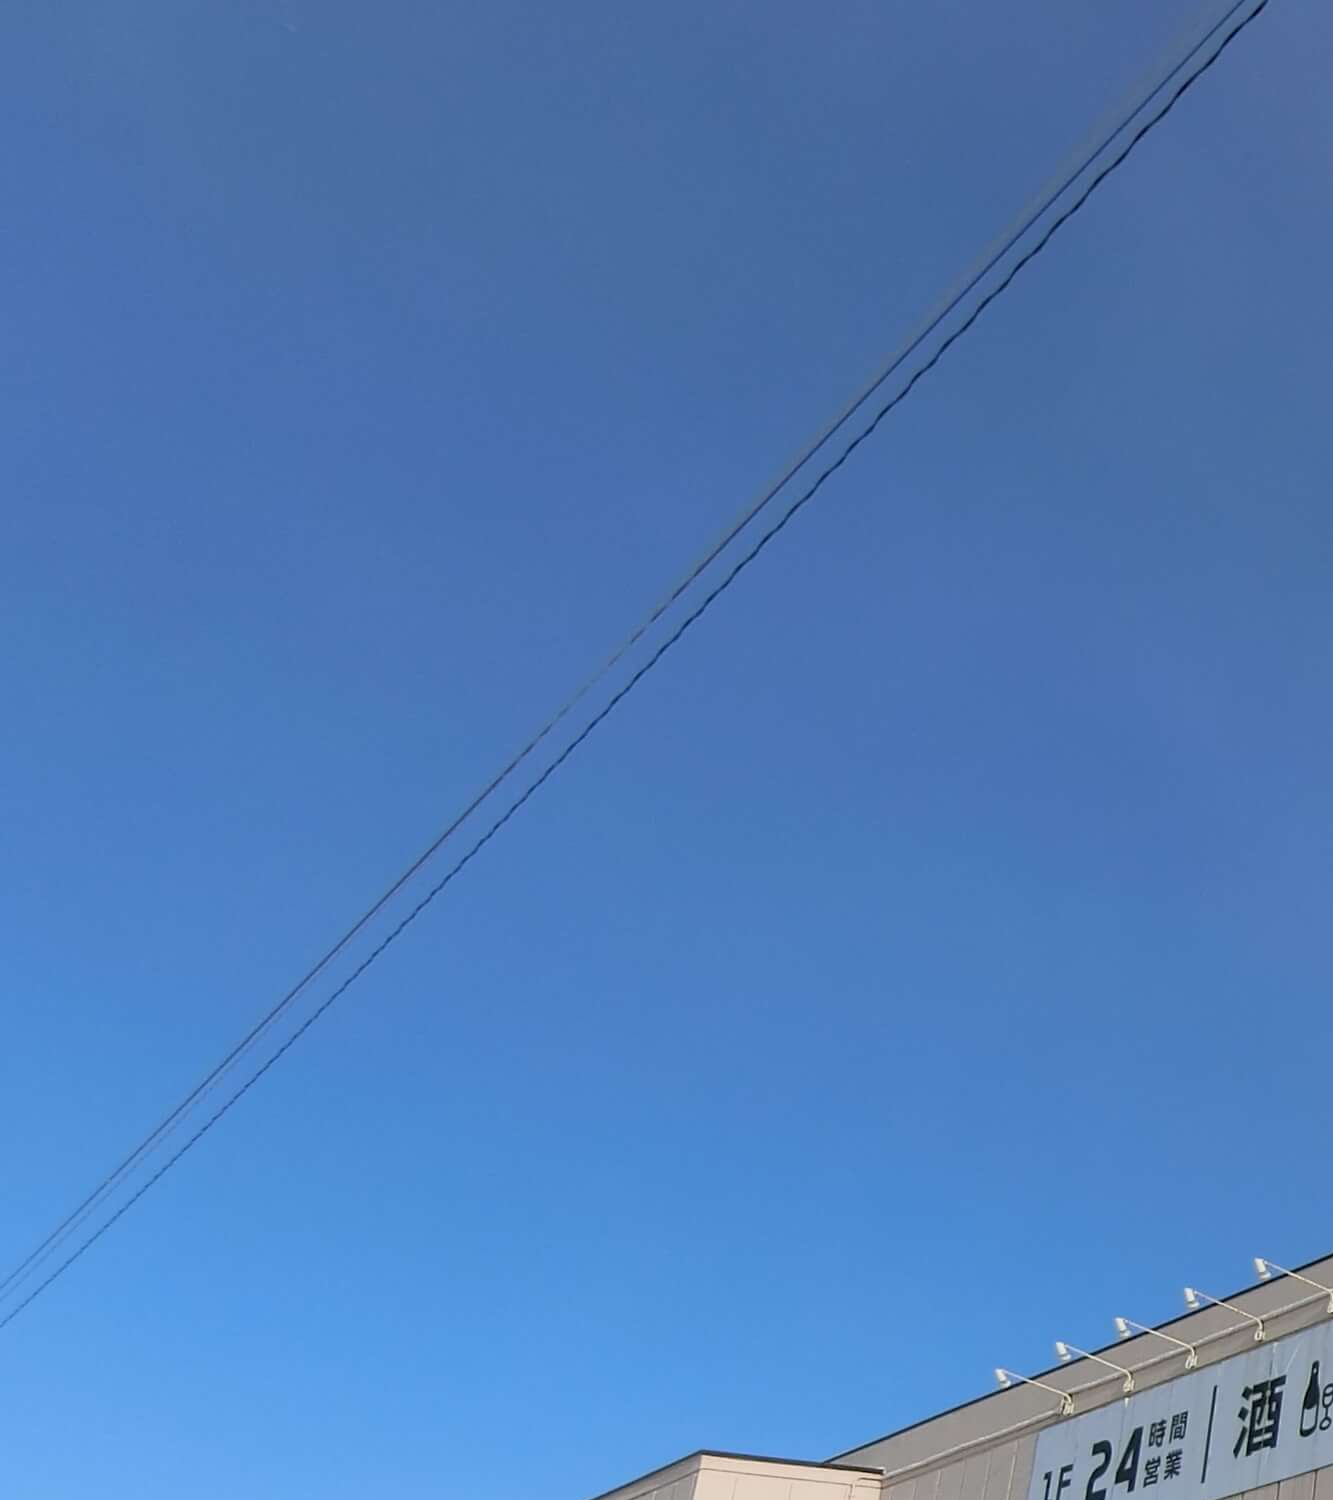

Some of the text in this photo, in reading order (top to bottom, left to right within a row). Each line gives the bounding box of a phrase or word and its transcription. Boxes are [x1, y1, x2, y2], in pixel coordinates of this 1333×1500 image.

[1148, 1411, 1188, 1447] 時間
[1233, 1375, 1286, 1458] 酒
[1143, 1450, 1182, 1488] 営業
